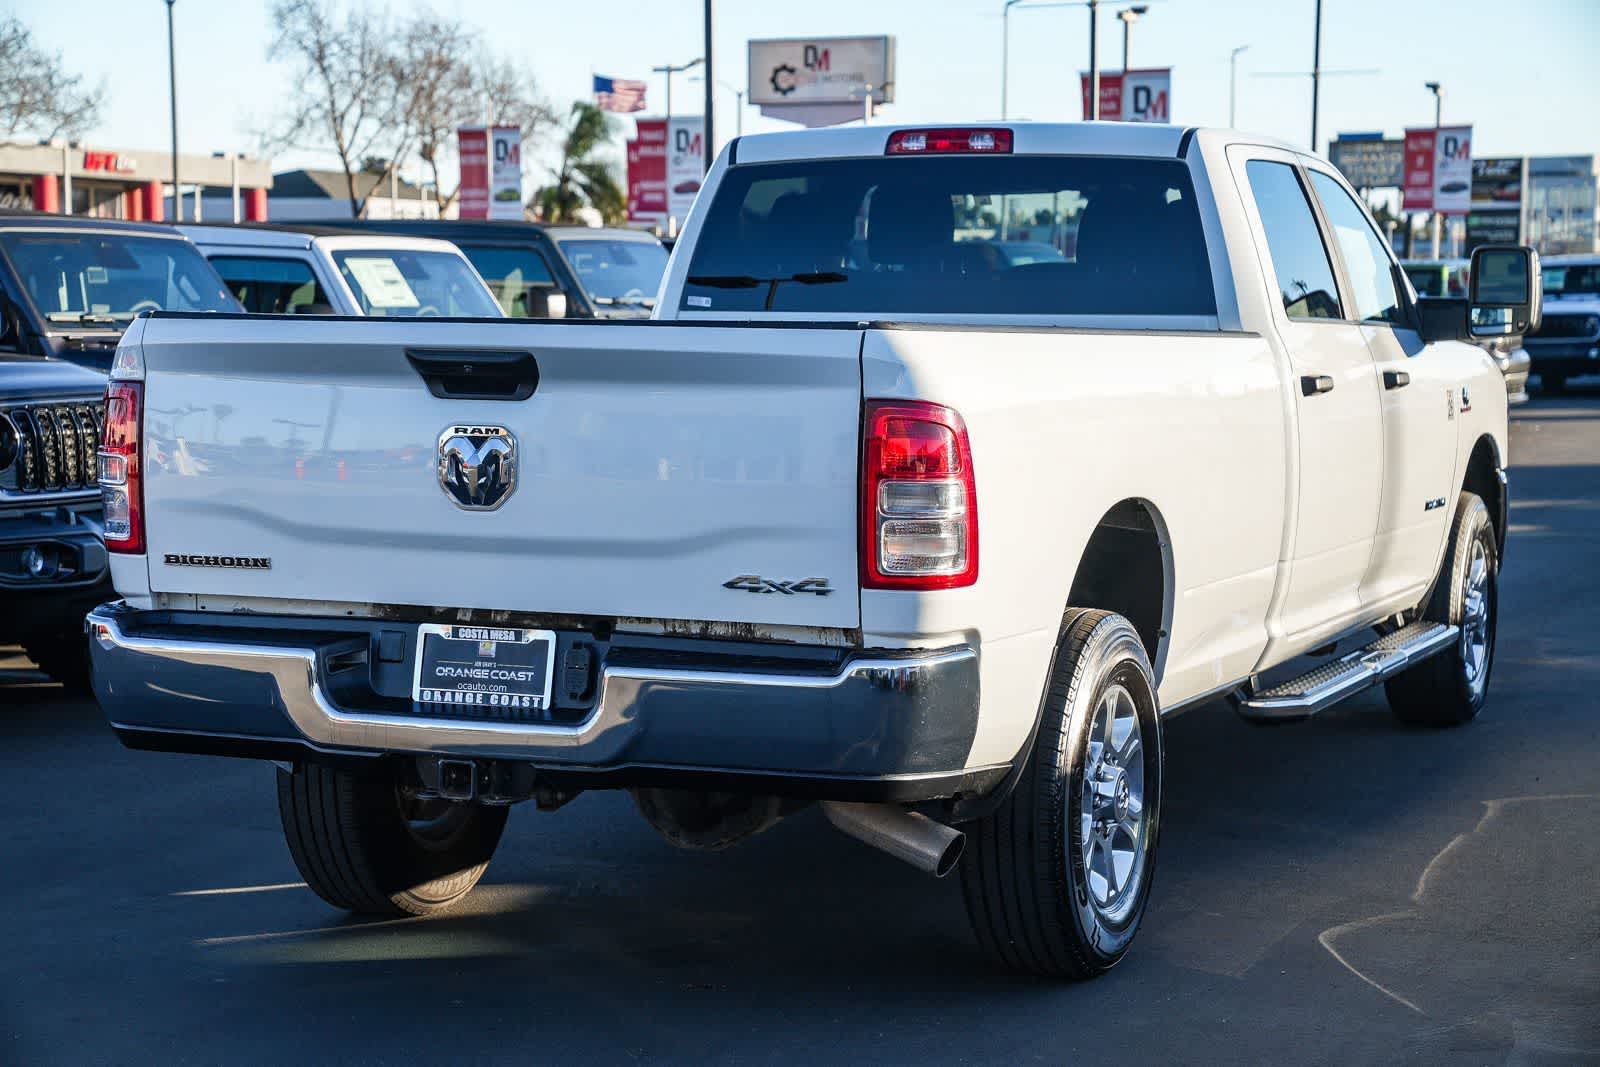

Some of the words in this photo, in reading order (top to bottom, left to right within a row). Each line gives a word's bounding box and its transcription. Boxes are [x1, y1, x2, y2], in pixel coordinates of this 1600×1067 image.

[803, 45, 831, 72] DM
[1133, 85, 1168, 120] DM
[676, 128, 702, 157] DM
[1444, 136, 1470, 160] DM
[454, 427, 500, 435] RAM
[163, 554, 272, 570] BIGHORN
[458, 627, 489, 640] COSTA
[490, 629, 516, 641] MESA
[435, 666, 489, 679] ORANGE
[490, 669, 535, 681] COAST
[458, 683, 507, 692] ocauto.com
[423, 690, 483, 703] ORANGE
[490, 695, 541, 707] COAST
